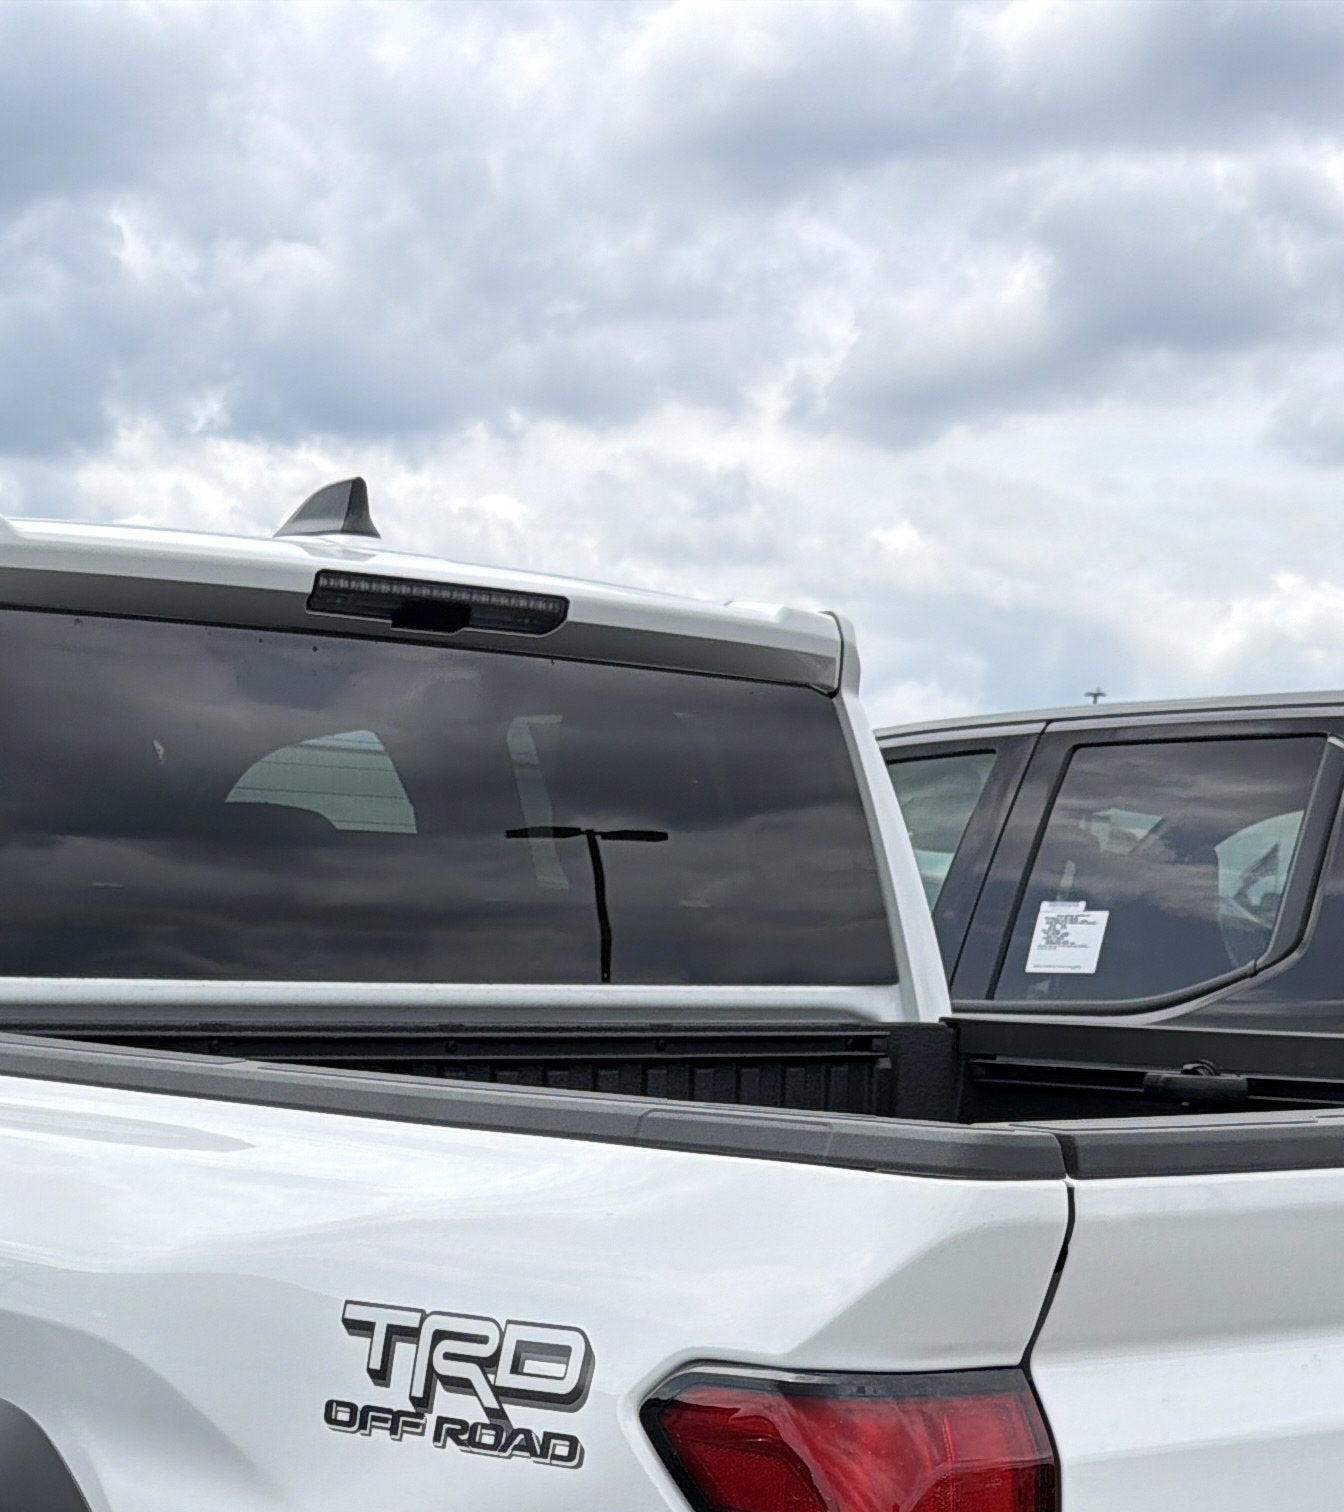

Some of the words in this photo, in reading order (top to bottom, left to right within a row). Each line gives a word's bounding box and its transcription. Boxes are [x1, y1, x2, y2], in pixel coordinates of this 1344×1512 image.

[341, 1299, 595, 1429] TRD
[323, 1399, 427, 1441] OFF
[432, 1415, 585, 1470] ROAD
